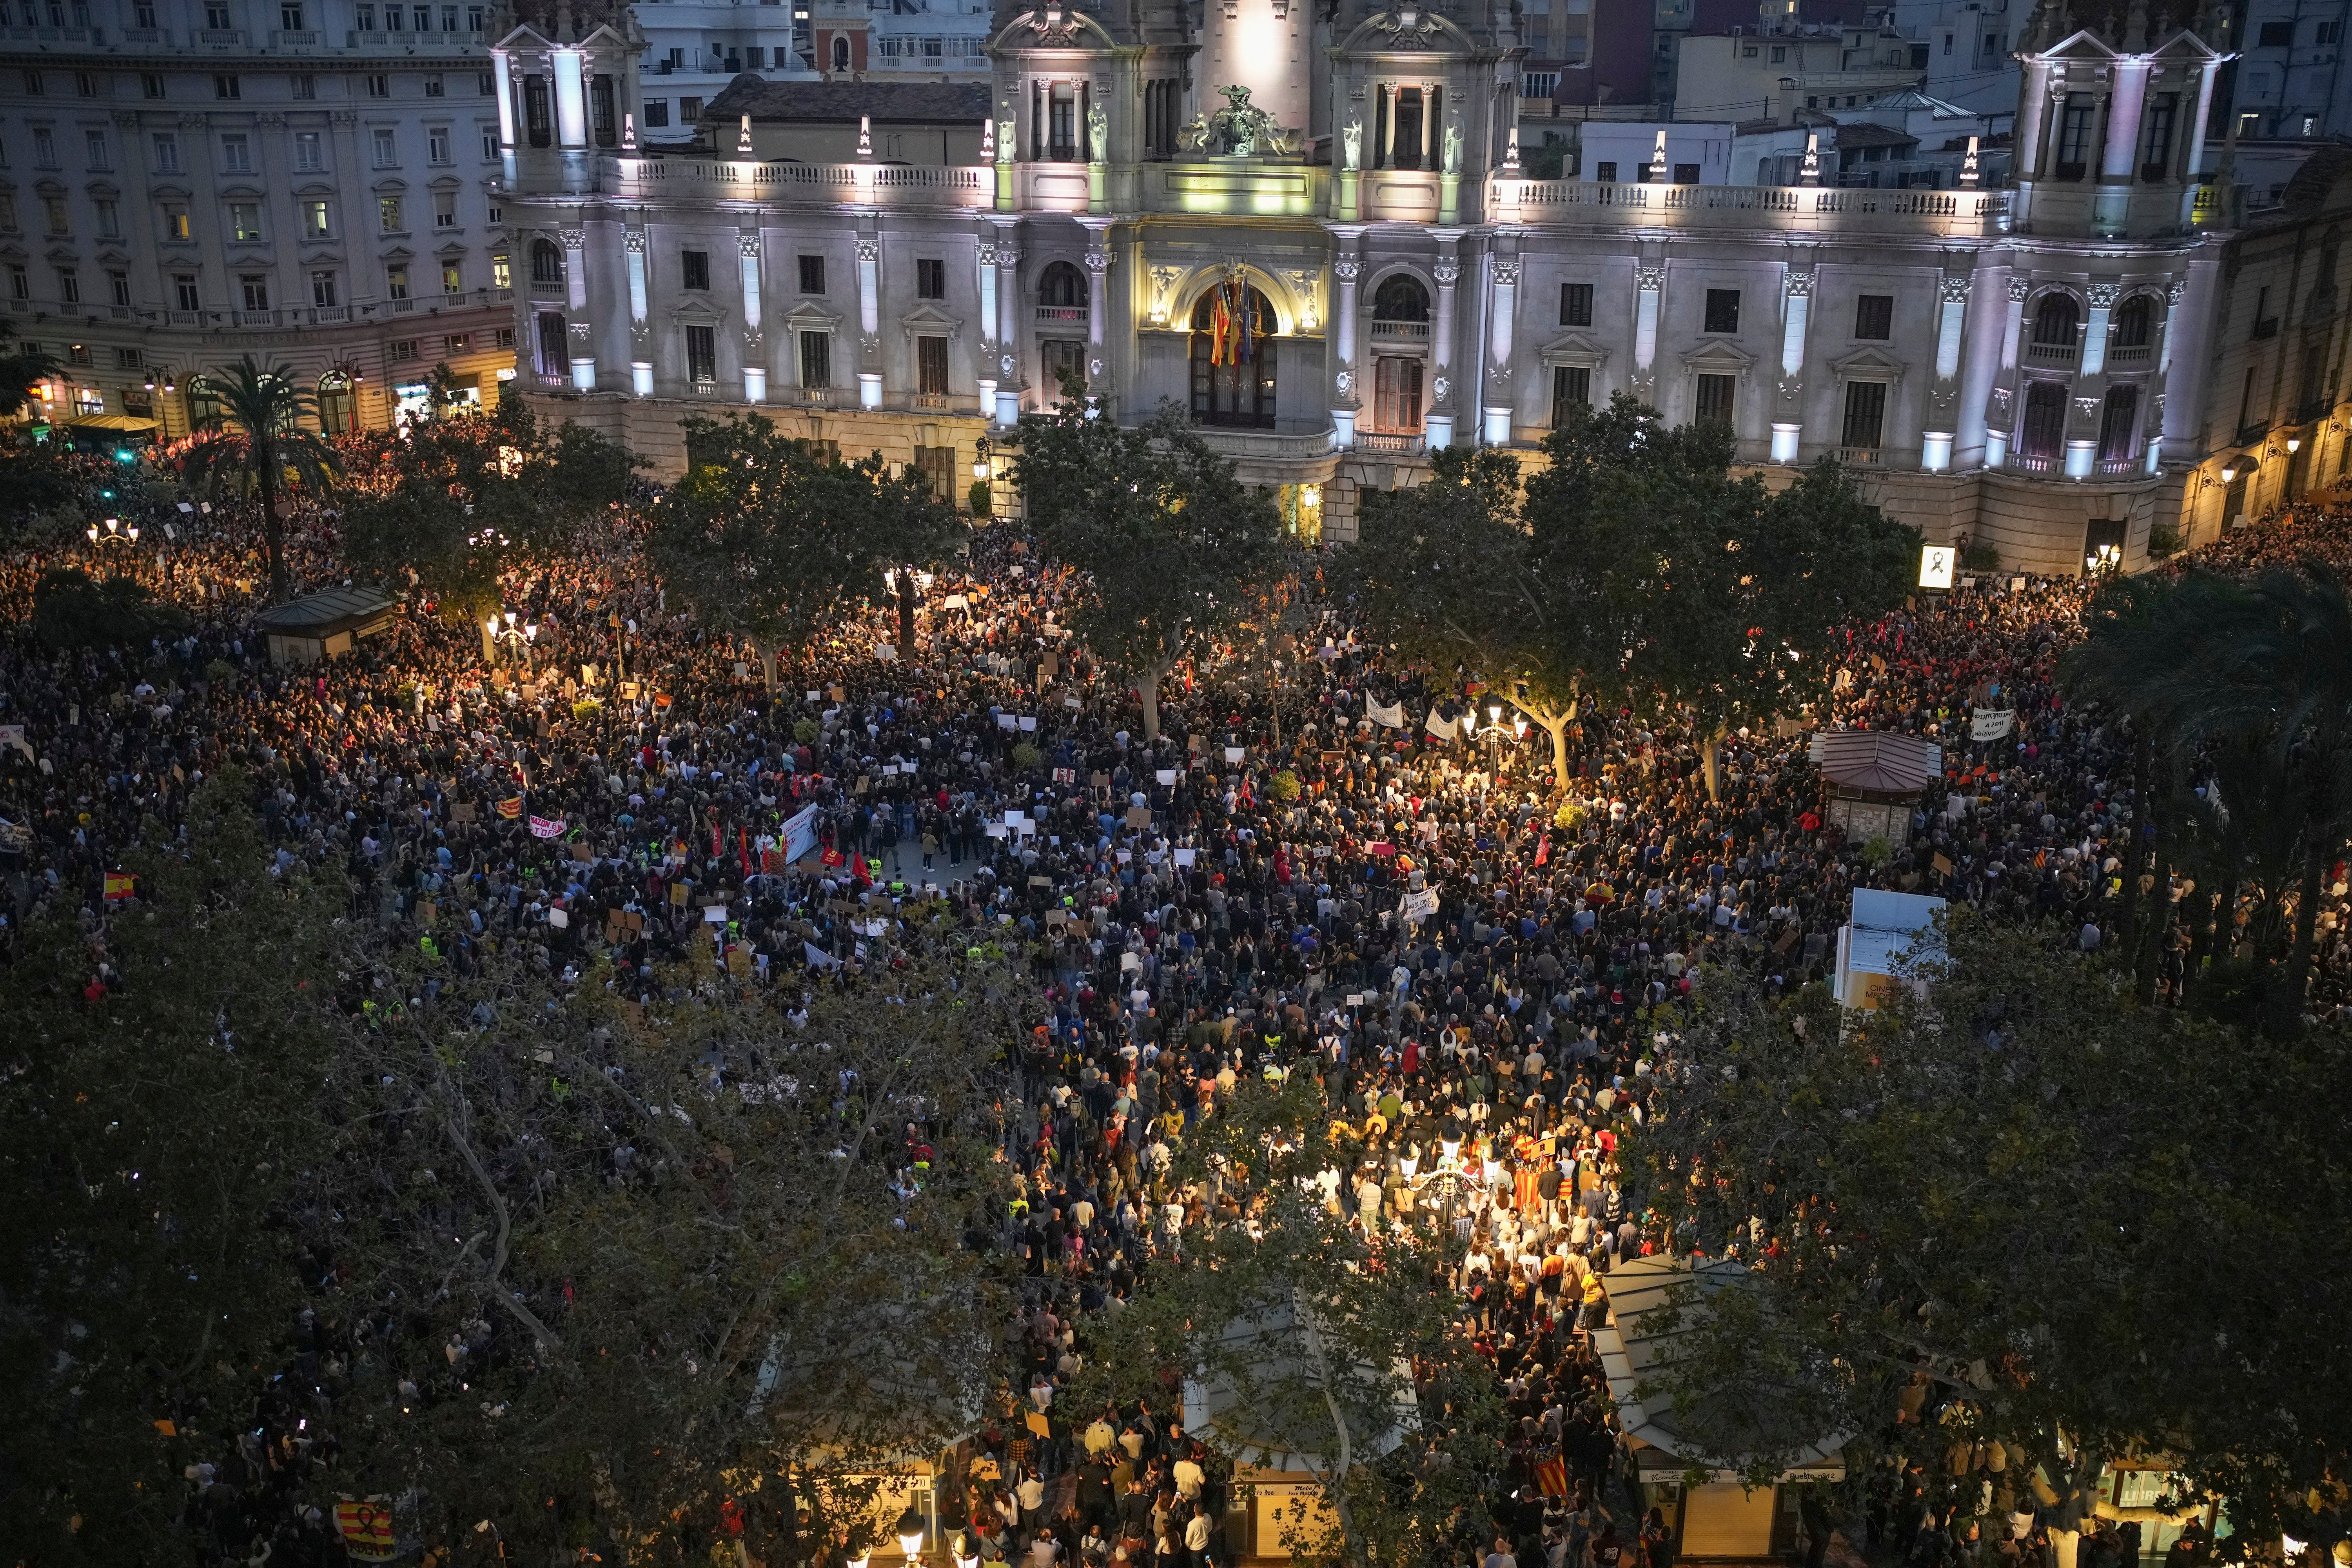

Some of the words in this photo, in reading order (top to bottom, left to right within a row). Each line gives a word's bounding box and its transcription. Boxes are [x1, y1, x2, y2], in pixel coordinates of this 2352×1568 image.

[800, 811, 813, 822] LLUITAR
[1071, 1292, 1080, 1302] Lee
[1651, 1473, 1679, 1481] Vicenta
[919, 1479, 926, 1487] 10
